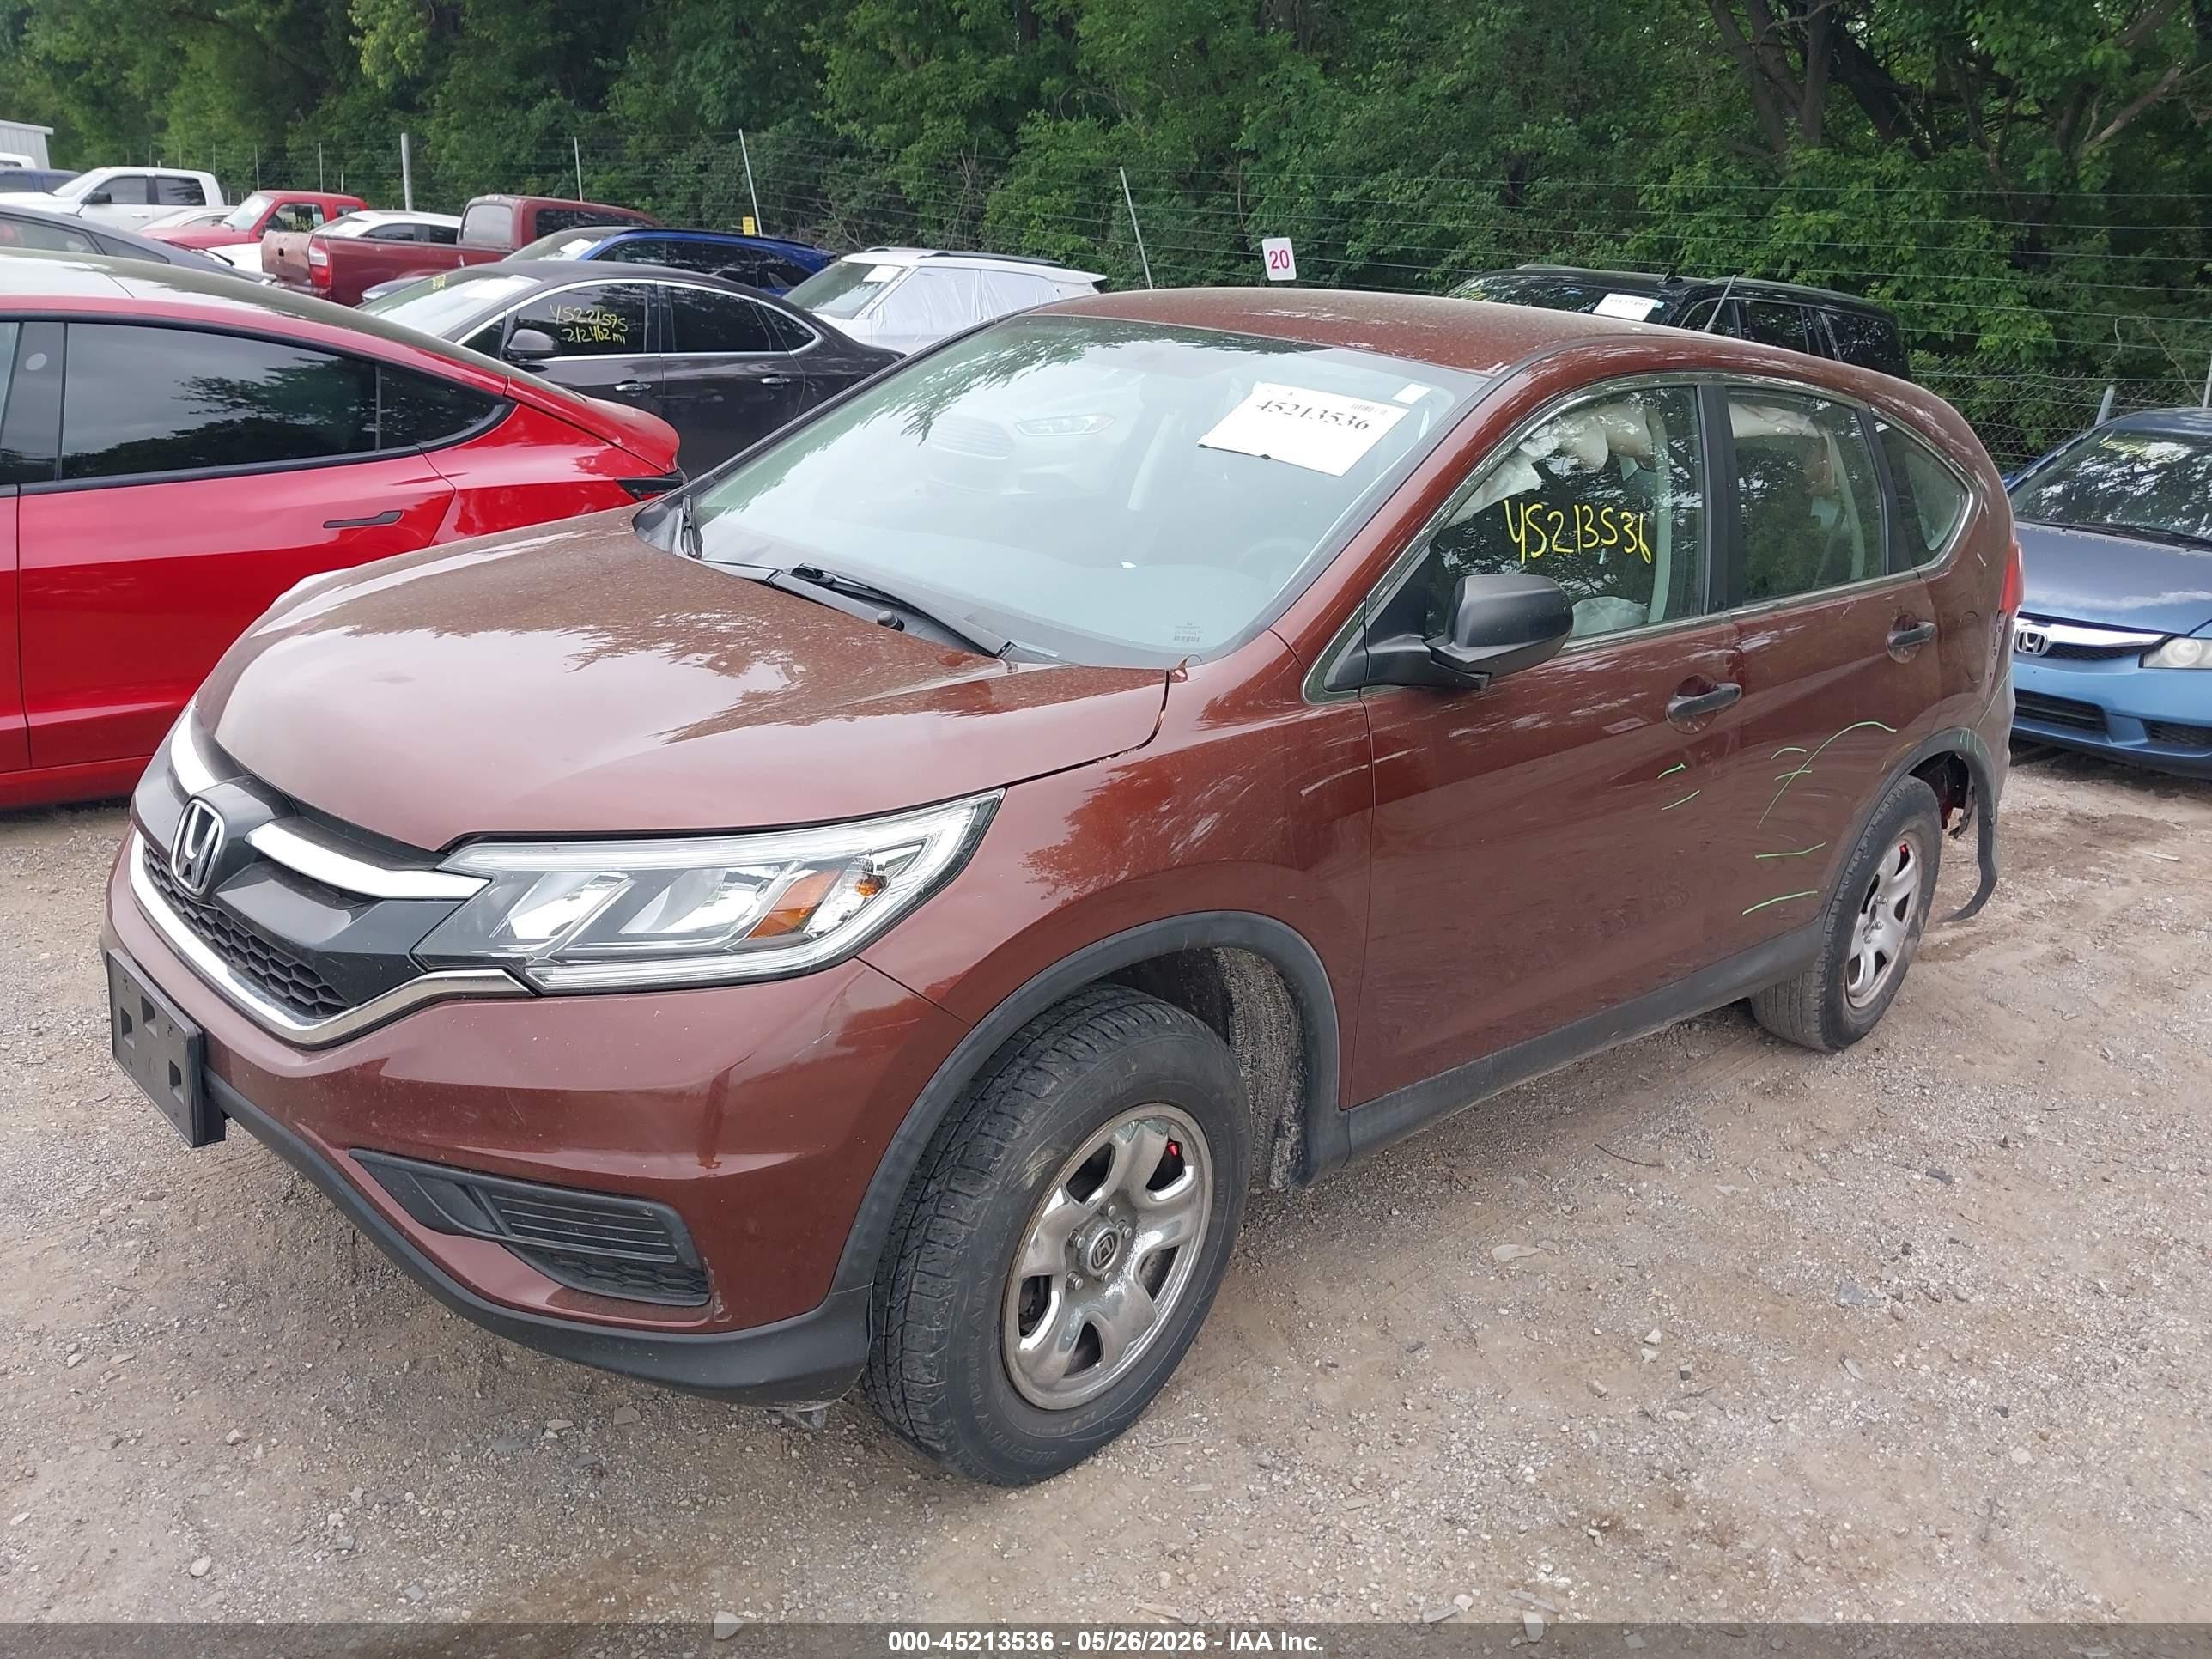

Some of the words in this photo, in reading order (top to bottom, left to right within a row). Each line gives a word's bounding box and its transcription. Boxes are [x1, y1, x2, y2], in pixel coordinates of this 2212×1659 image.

[1268, 249, 1291, 270] 20
[1256, 399, 1370, 430] 45213536
[1504, 499, 1652, 565] 45213536
